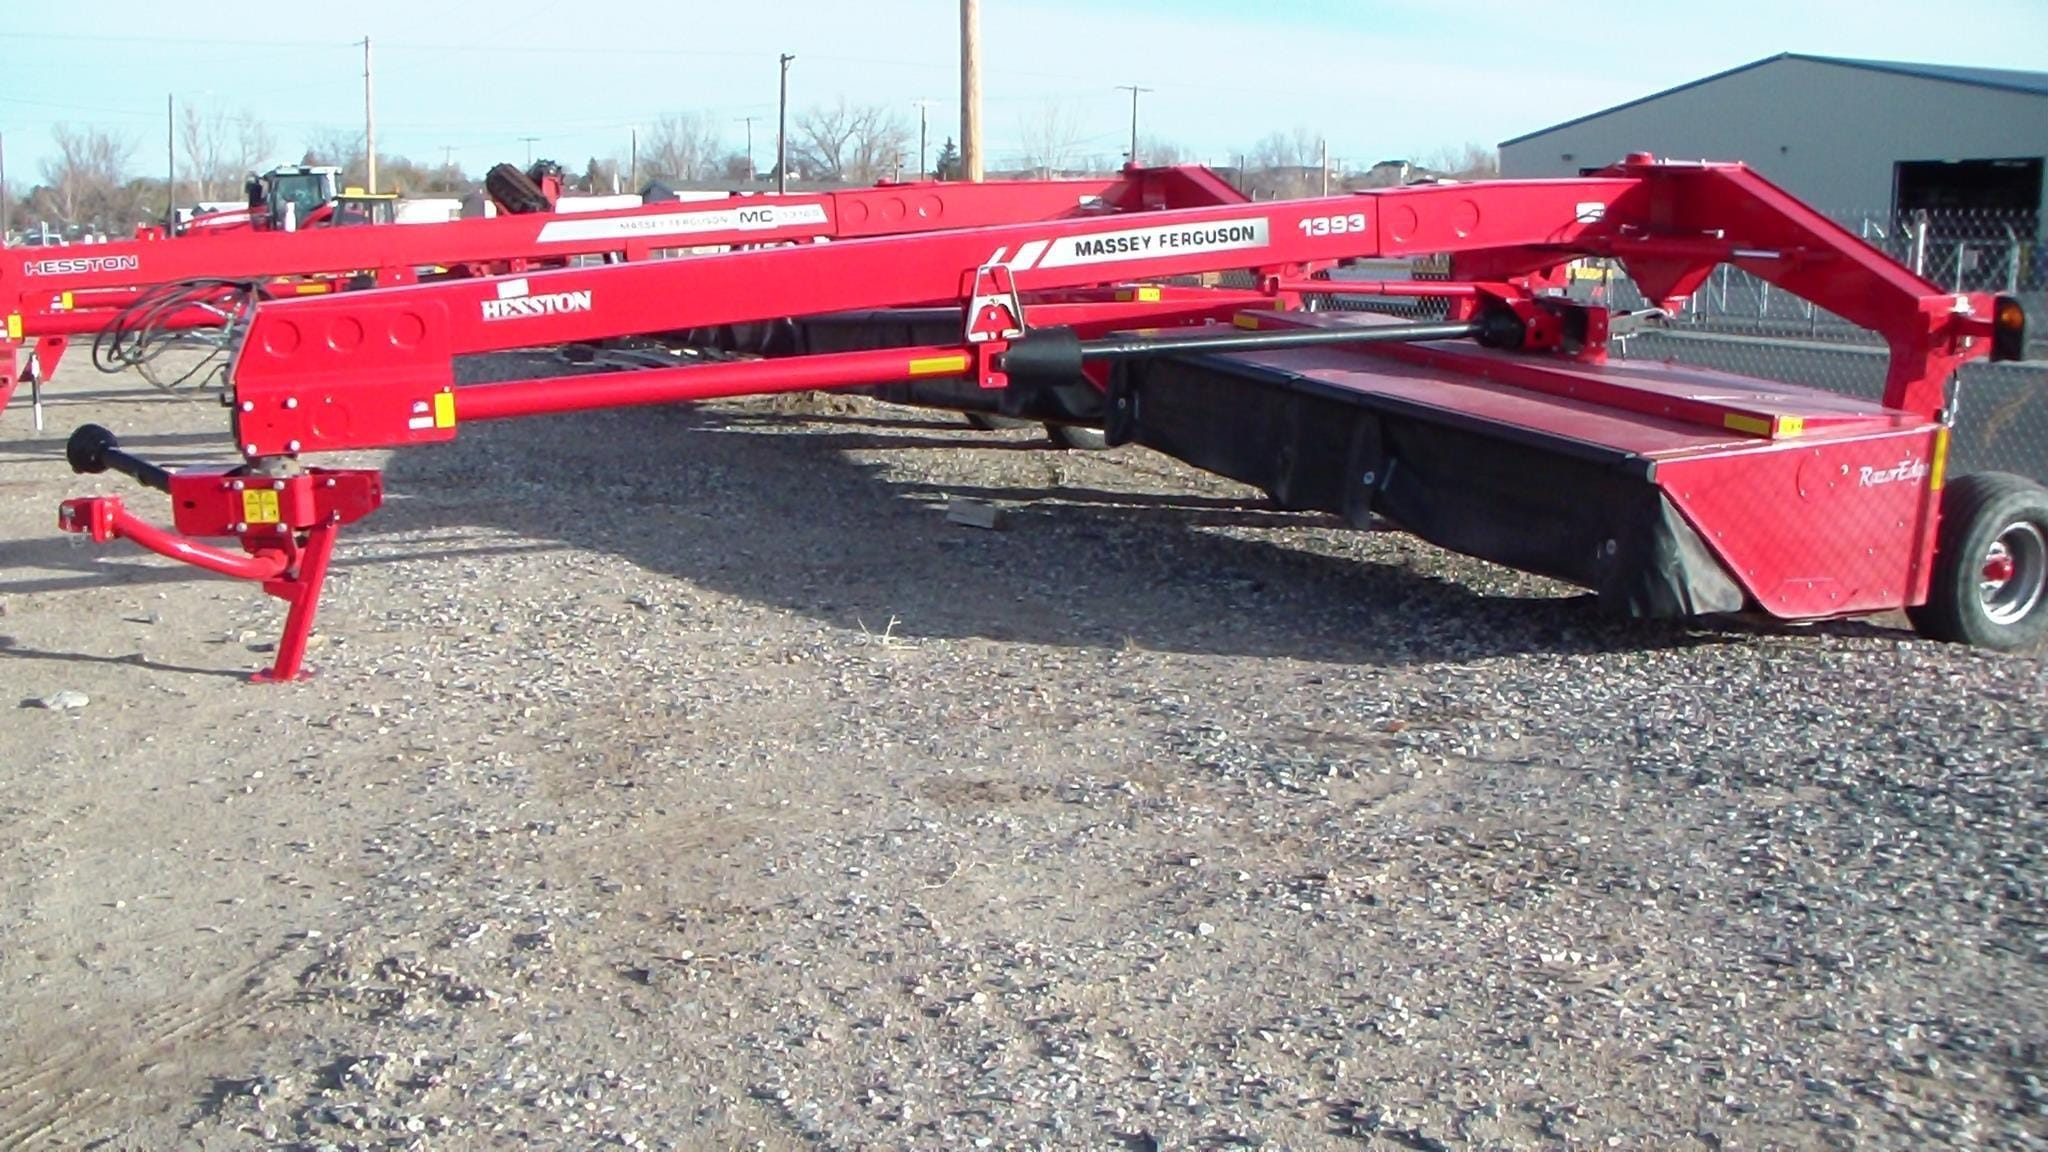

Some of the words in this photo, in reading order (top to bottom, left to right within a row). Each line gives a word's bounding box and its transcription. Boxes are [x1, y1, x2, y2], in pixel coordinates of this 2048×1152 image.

[740, 209, 773, 223] MC
[1299, 214, 1366, 236] 1393
[1075, 236, 1151, 257] MASSEY
[1159, 225, 1255, 248] FERGUSON
[24, 255, 138, 276] HESSTON
[480, 290, 592, 321] HESSTON
